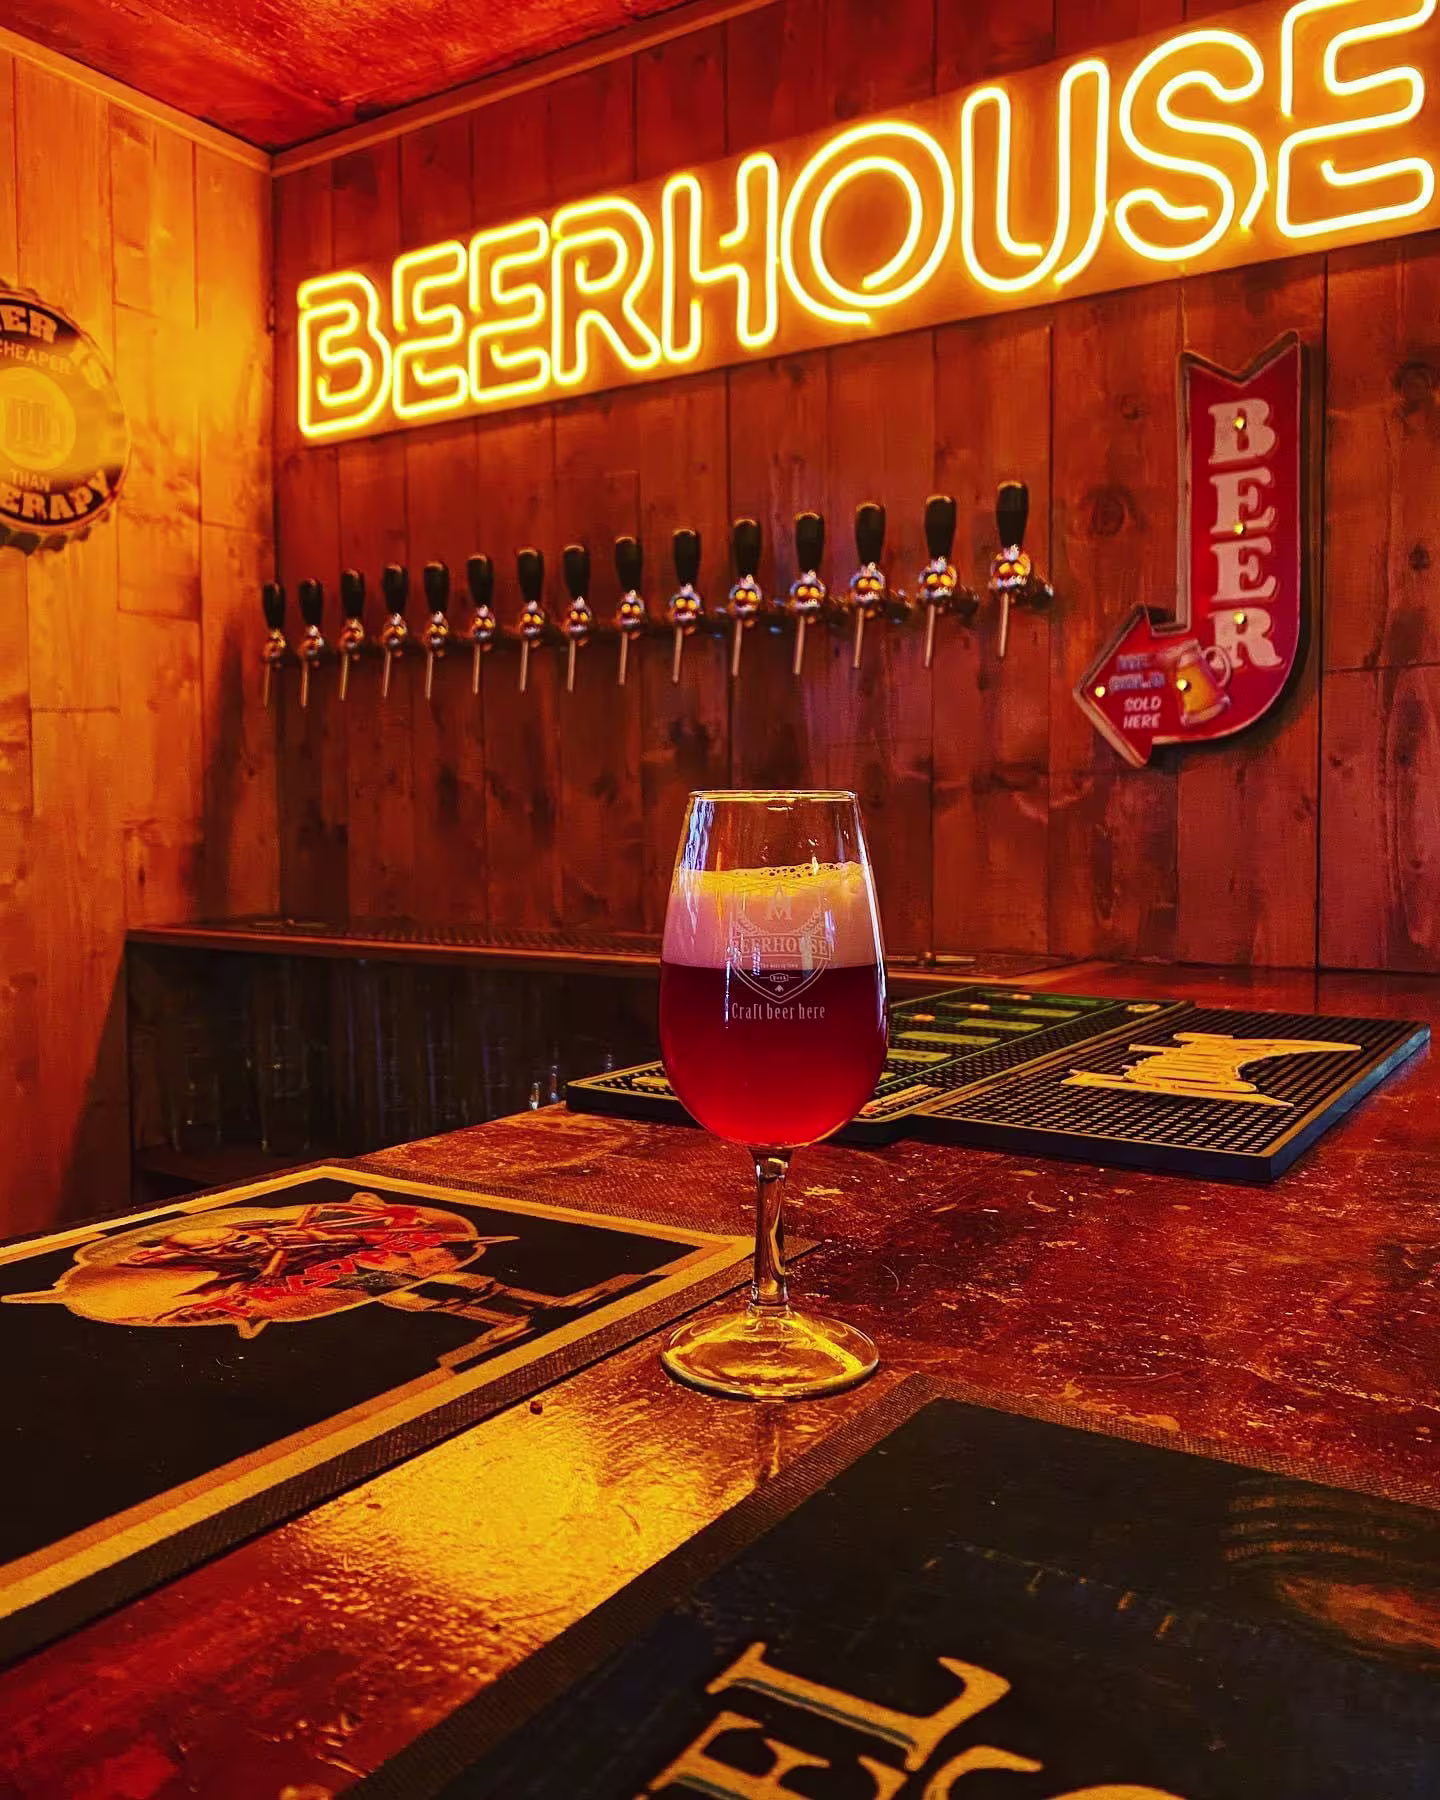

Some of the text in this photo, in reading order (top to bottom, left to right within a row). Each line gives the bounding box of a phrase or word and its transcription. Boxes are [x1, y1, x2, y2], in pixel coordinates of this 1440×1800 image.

[298, 0, 1437, 440] BEERHOUSE
[0, 305, 57, 343] ER
[0, 339, 72, 375] HEAPER
[1207, 399, 1282, 668] BEER
[1123, 713, 1160, 728] HERE
[1124, 696, 1161, 712] SOLD
[731, 1002, 826, 1020] Craft beer here
